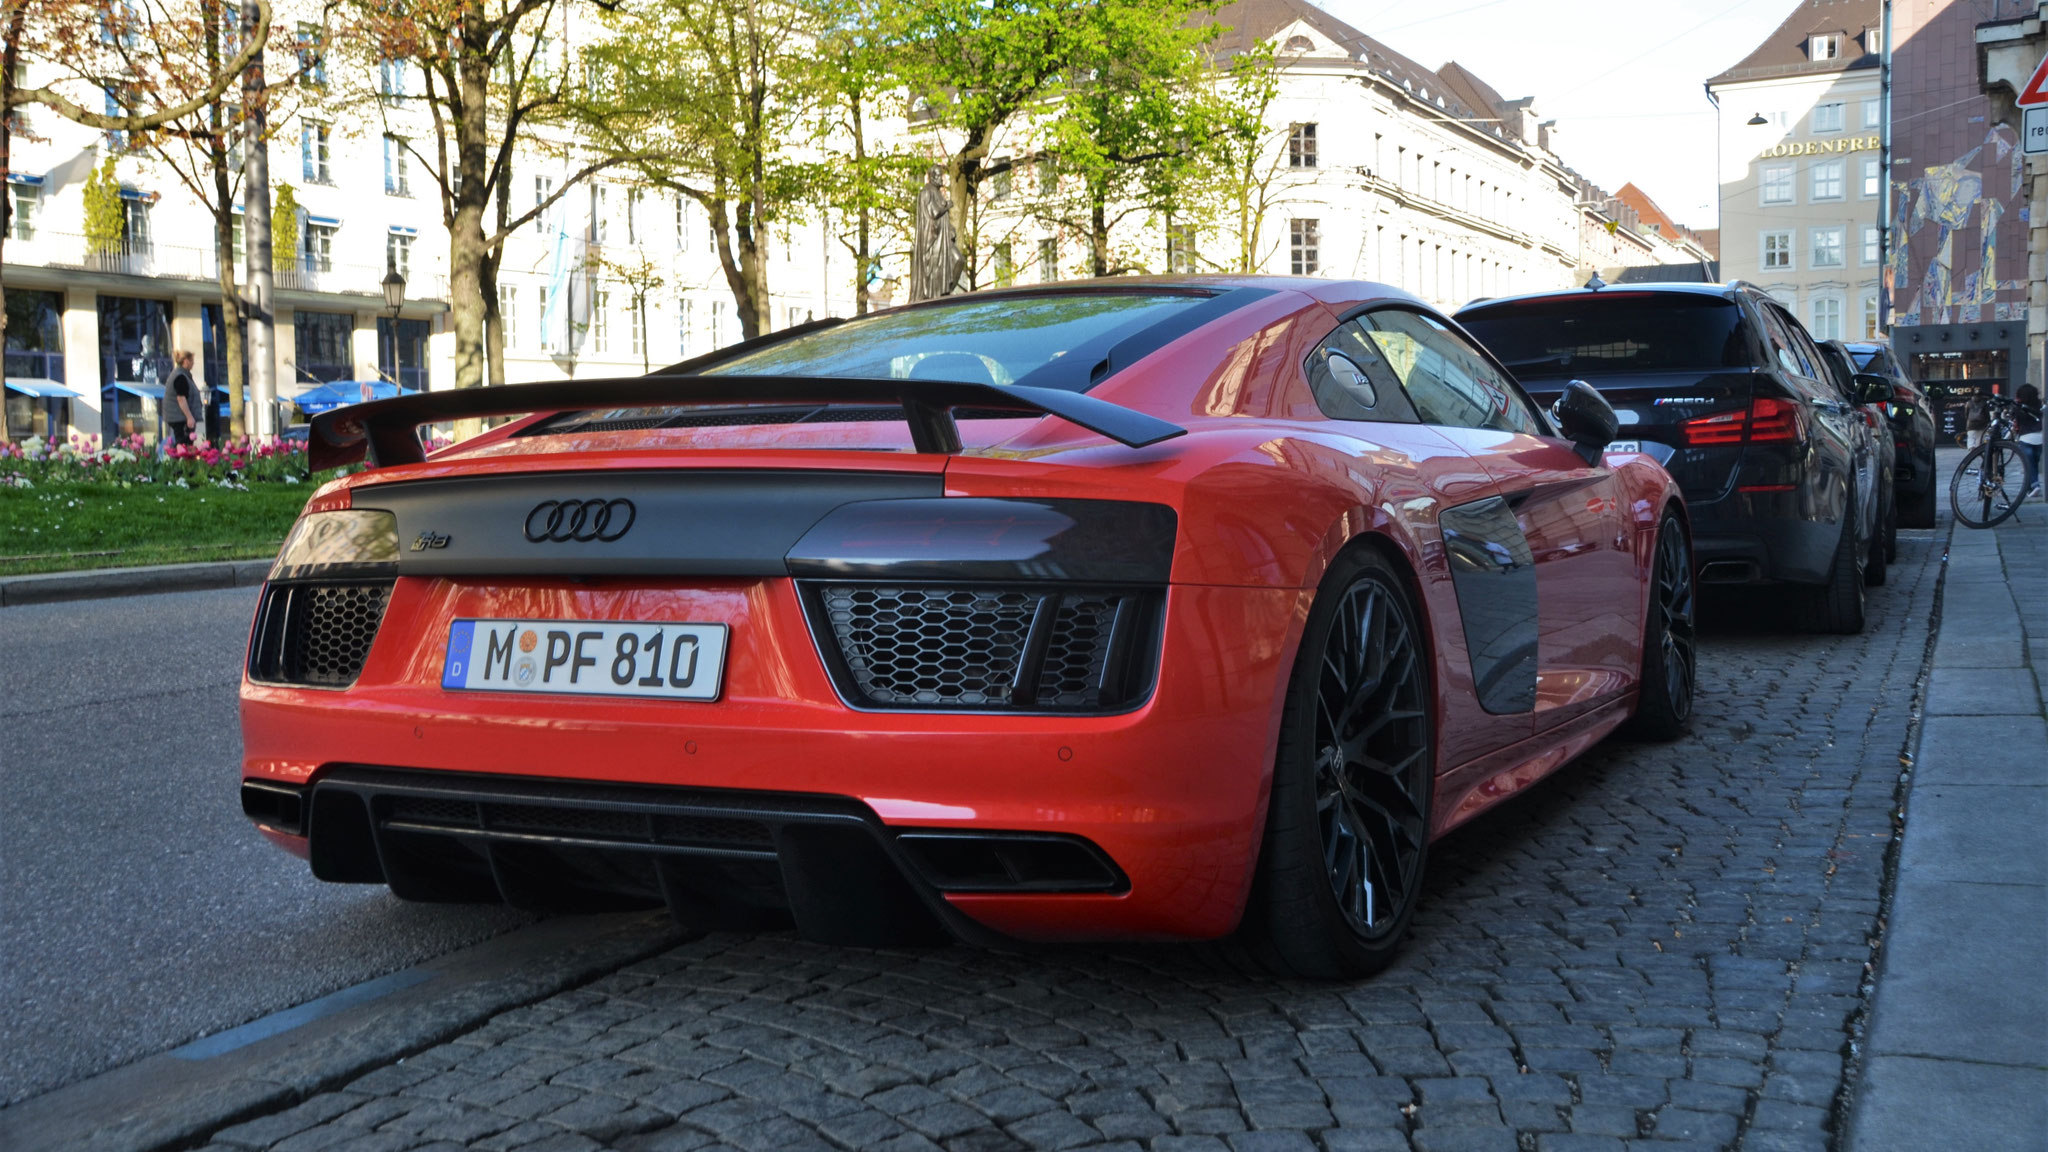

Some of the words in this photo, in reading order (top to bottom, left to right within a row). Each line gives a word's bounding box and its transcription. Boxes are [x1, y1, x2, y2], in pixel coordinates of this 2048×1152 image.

[1760, 136, 1880, 158] LODENFRE
[452, 661, 462, 677] D
[484, 628, 515, 681] M
[543, 631, 603, 684] PF
[611, 631, 699, 689] 810
